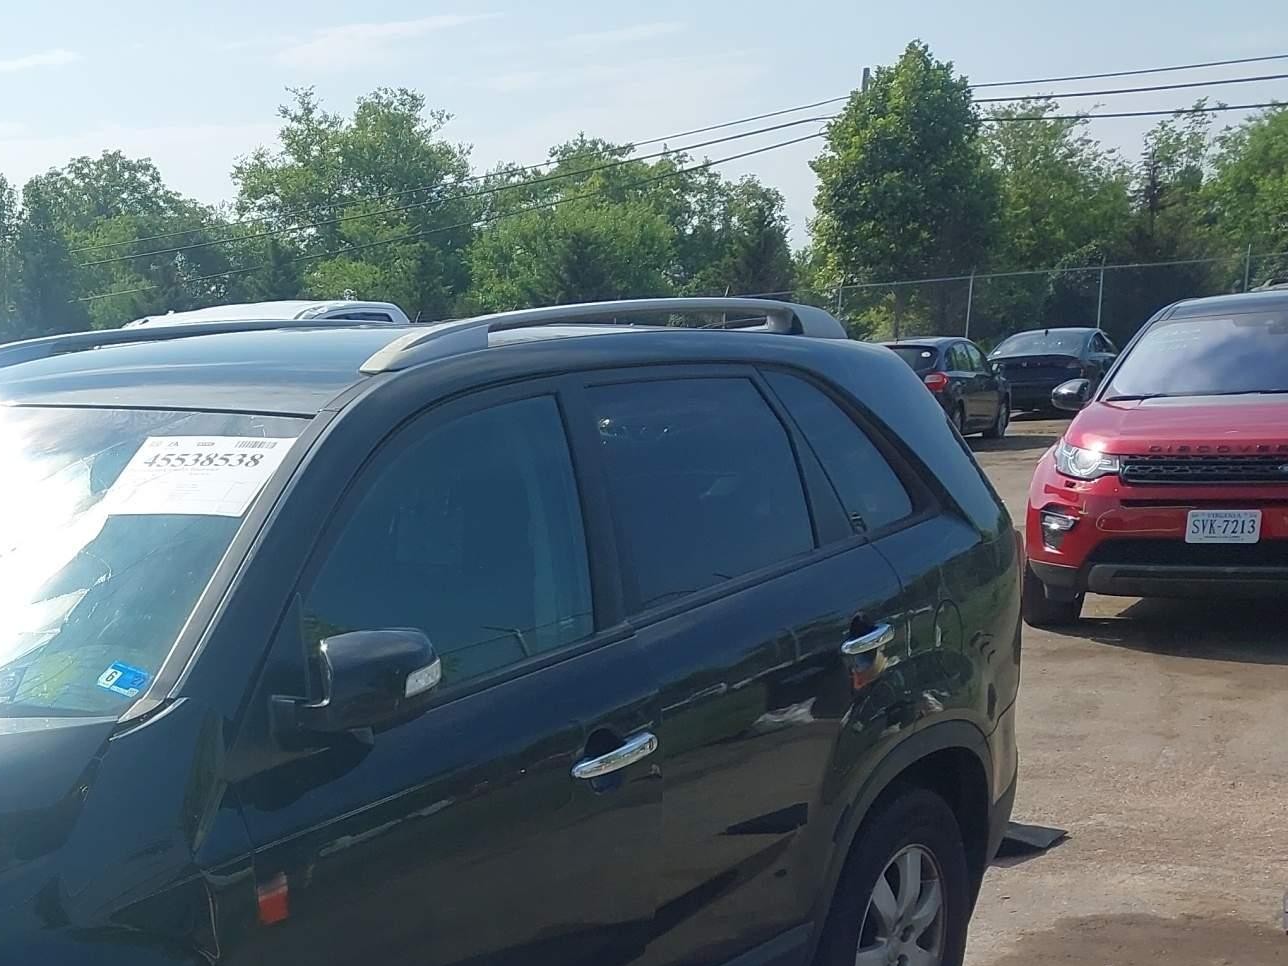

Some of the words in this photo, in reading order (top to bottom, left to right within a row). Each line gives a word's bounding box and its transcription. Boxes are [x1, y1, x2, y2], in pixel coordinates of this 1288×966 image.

[144, 452, 265, 468] 45538538
[1192, 519, 1256, 535] SVK-7213
[105, 670, 118, 682] 6
